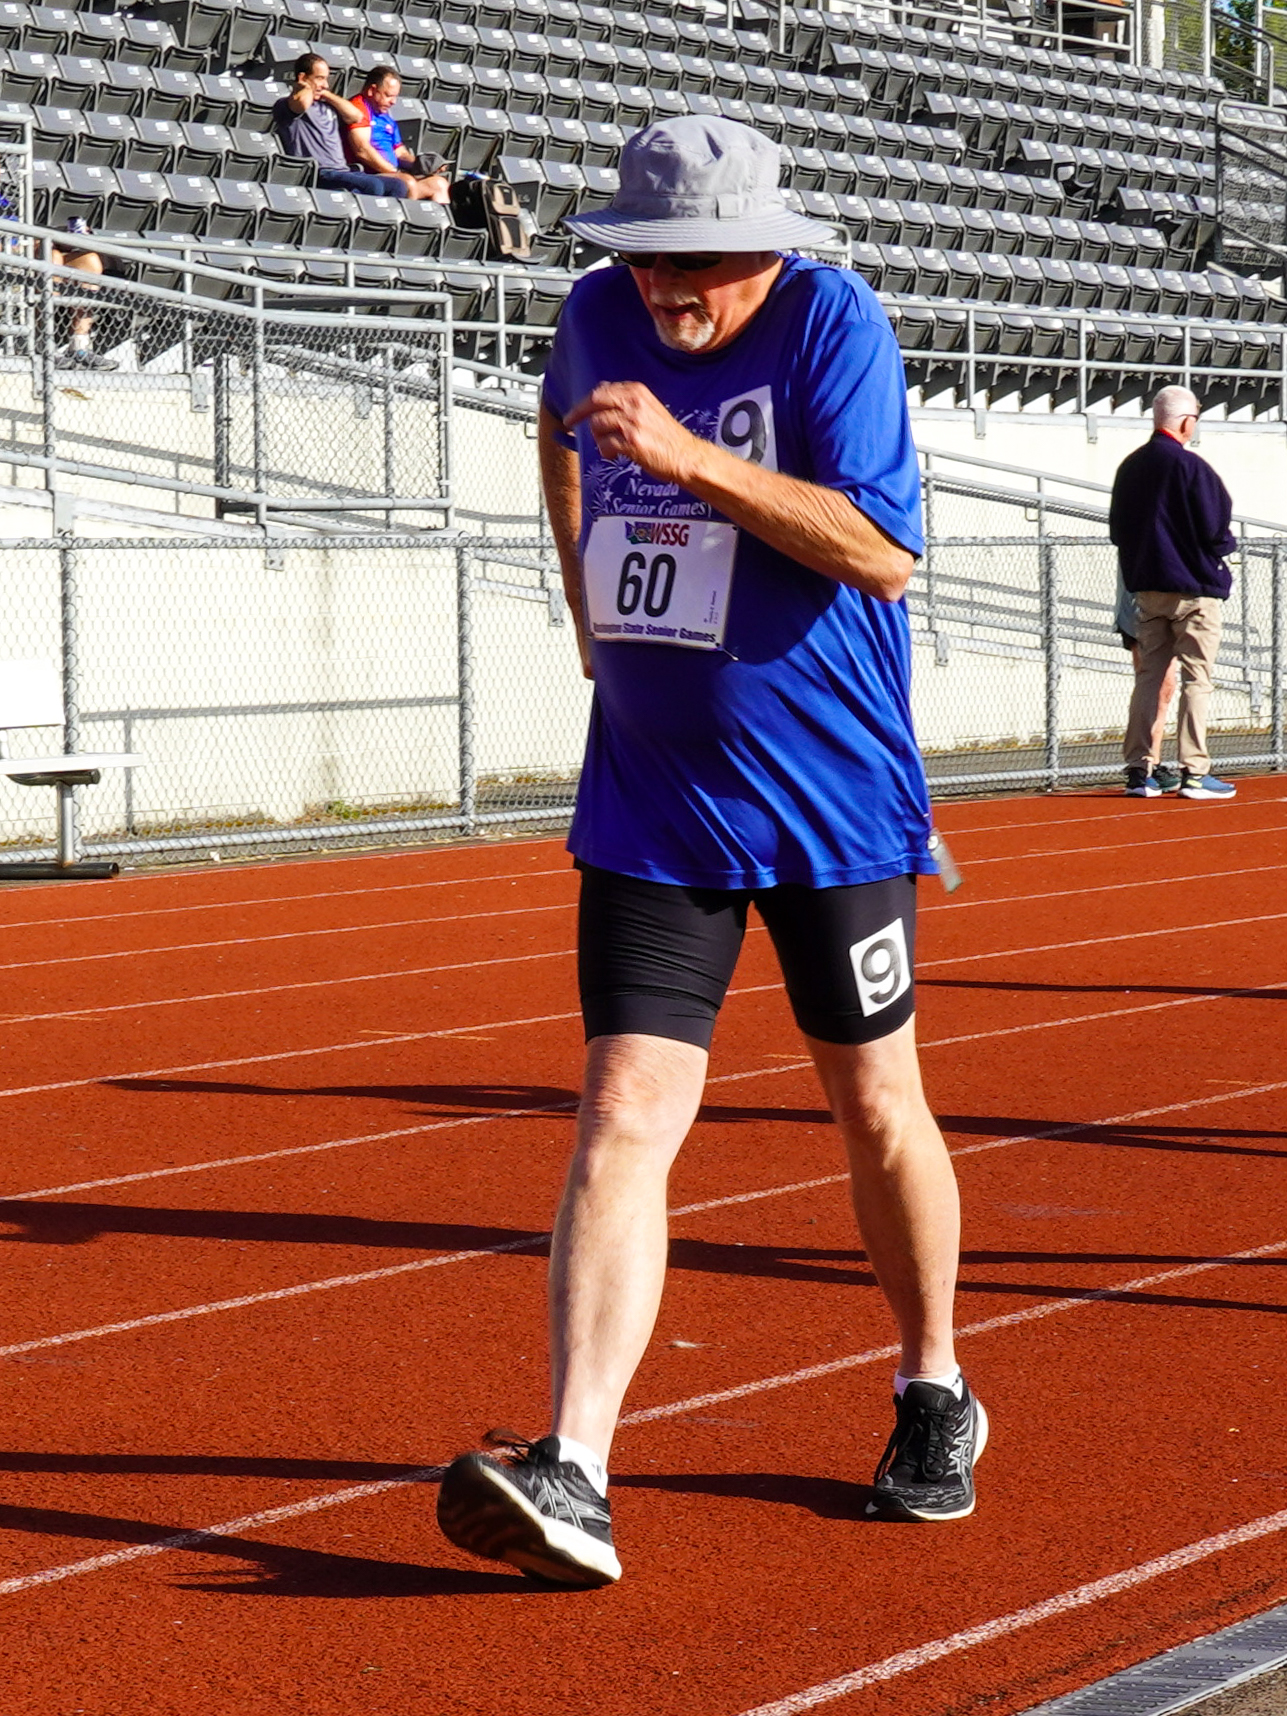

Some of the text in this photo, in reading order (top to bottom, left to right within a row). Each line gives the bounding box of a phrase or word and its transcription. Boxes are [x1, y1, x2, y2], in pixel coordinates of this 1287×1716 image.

[721, 399, 767, 463] 9
[624, 478, 680, 496] Nevada
[612, 498, 706, 516] Senior Games
[651, 523, 690, 547] WSSG
[616, 552, 676, 617] 60
[645, 623, 678, 638] Senior
[679, 627, 717, 642] Games
[861, 938, 901, 1005] 9
